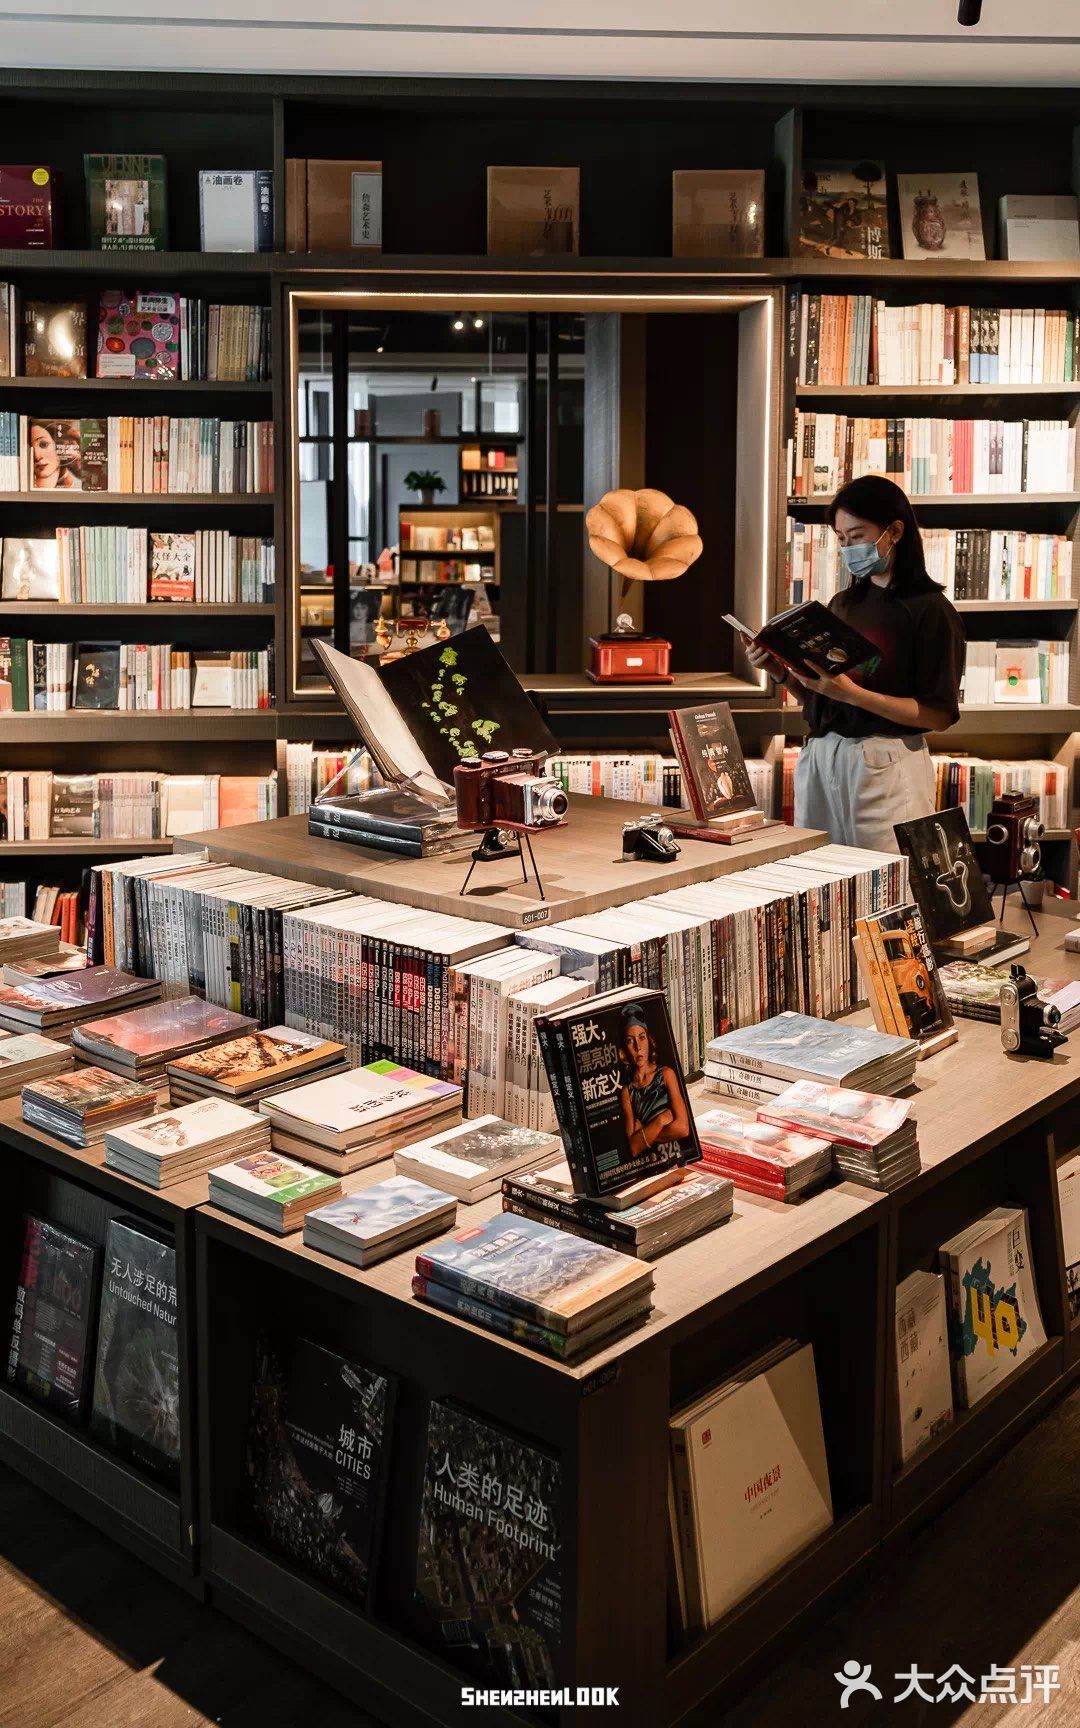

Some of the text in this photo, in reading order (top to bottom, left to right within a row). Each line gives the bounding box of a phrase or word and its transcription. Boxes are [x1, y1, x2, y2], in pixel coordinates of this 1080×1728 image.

[212, 174, 244, 186] 油画卷
[0, 204, 45, 217] STORY
[523, 910, 548, 924] 601-007
[577, 1043, 618, 1073] 漂亮的
[582, 1069, 623, 1102] 新定义
[1011, 1225, 1026, 1273] 巨变
[108, 1279, 152, 1313] Untouched
[338, 1423, 374, 1460] 城市
[335, 1449, 372, 1481] CITIES
[436, 1451, 549, 1533] 人类的足迹
[433, 1481, 556, 1562] Human Footprint
